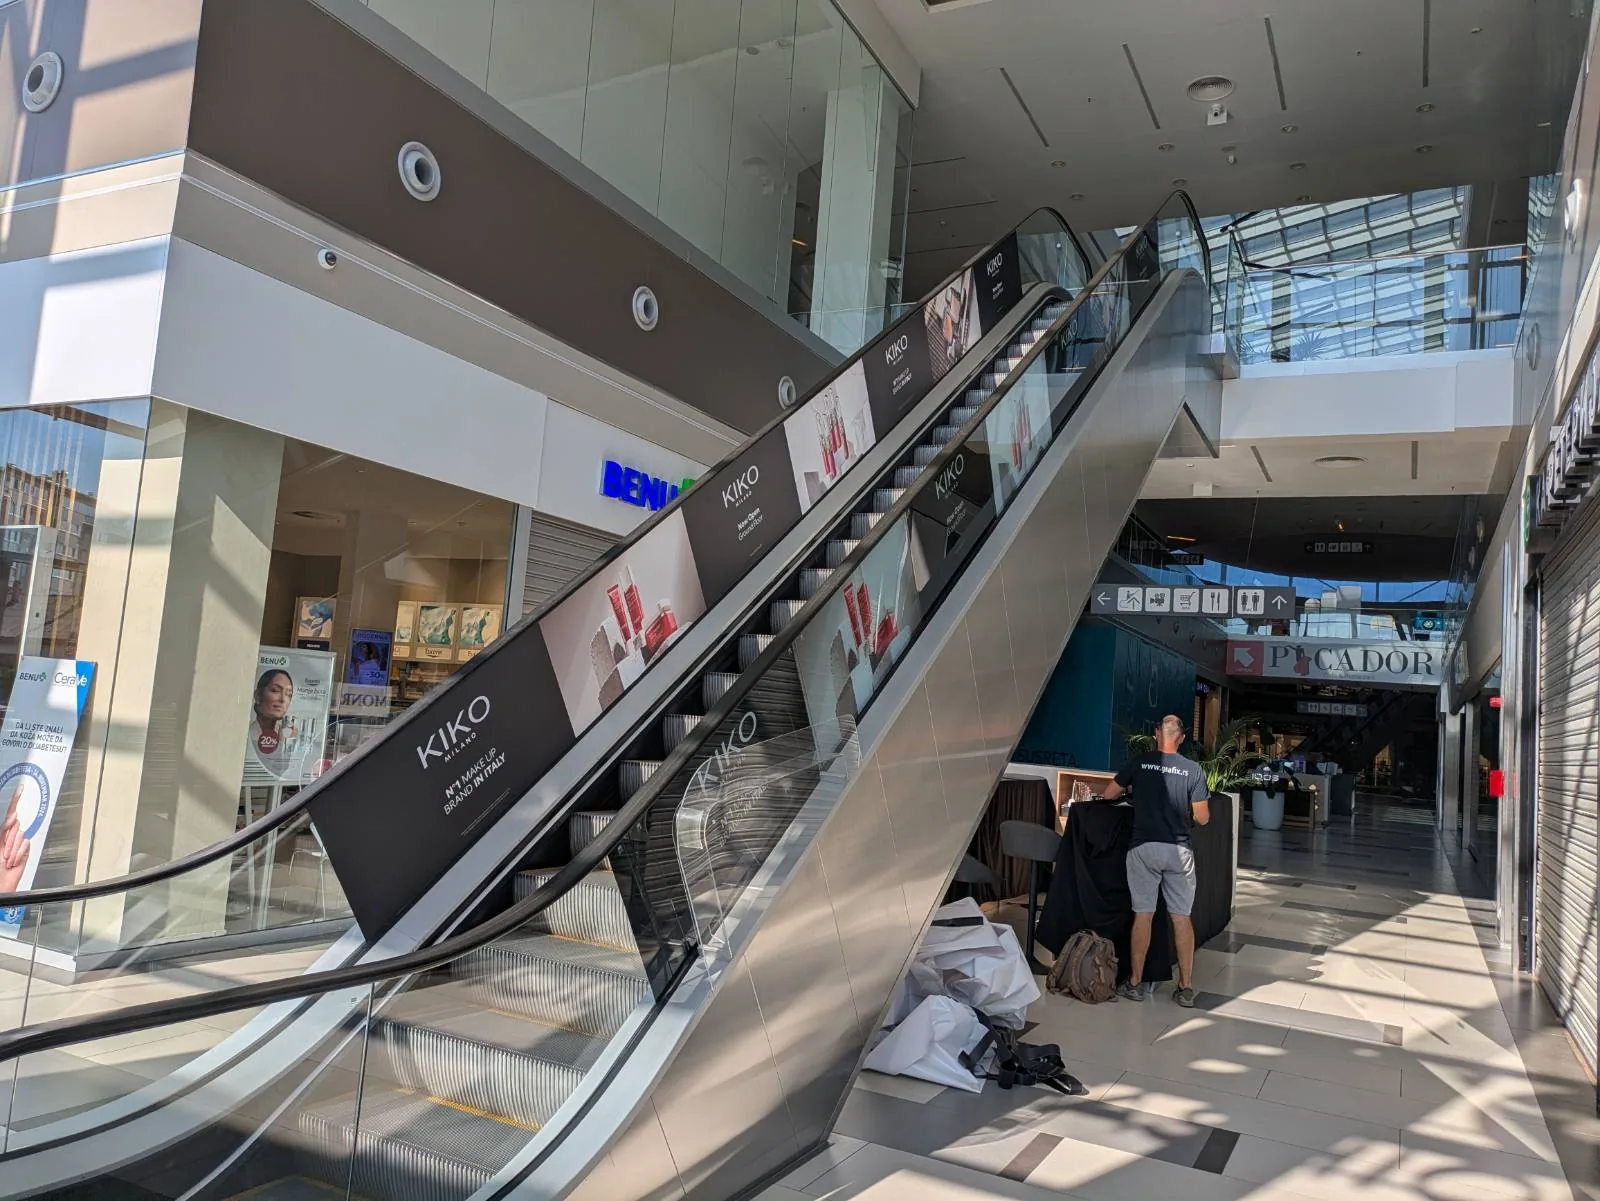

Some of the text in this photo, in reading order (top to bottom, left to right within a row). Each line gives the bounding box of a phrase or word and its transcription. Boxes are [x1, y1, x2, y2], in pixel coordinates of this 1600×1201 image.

[885, 335, 908, 365] KIKO
[721, 465, 760, 509] KIKO
[935, 453, 964, 500] KIKO
[260, 657, 279, 665] BENU
[20, 672, 40, 682] BENU
[54, 671, 88, 687] CeraVe
[44, 725, 64, 734] ZNALI
[54, 735, 63, 743] DA
[260, 735, 277, 745] 20%
[415, 695, 491, 769] KIKO
[444, 732, 477, 763] MILANO
[696, 711, 757, 795] KIKO
[461, 757, 486, 784] MAKE
[485, 747, 496, 762] UP
[443, 784, 473, 815] BRAND
[473, 773, 484, 788] IN
[484, 752, 506, 778] ITALY
